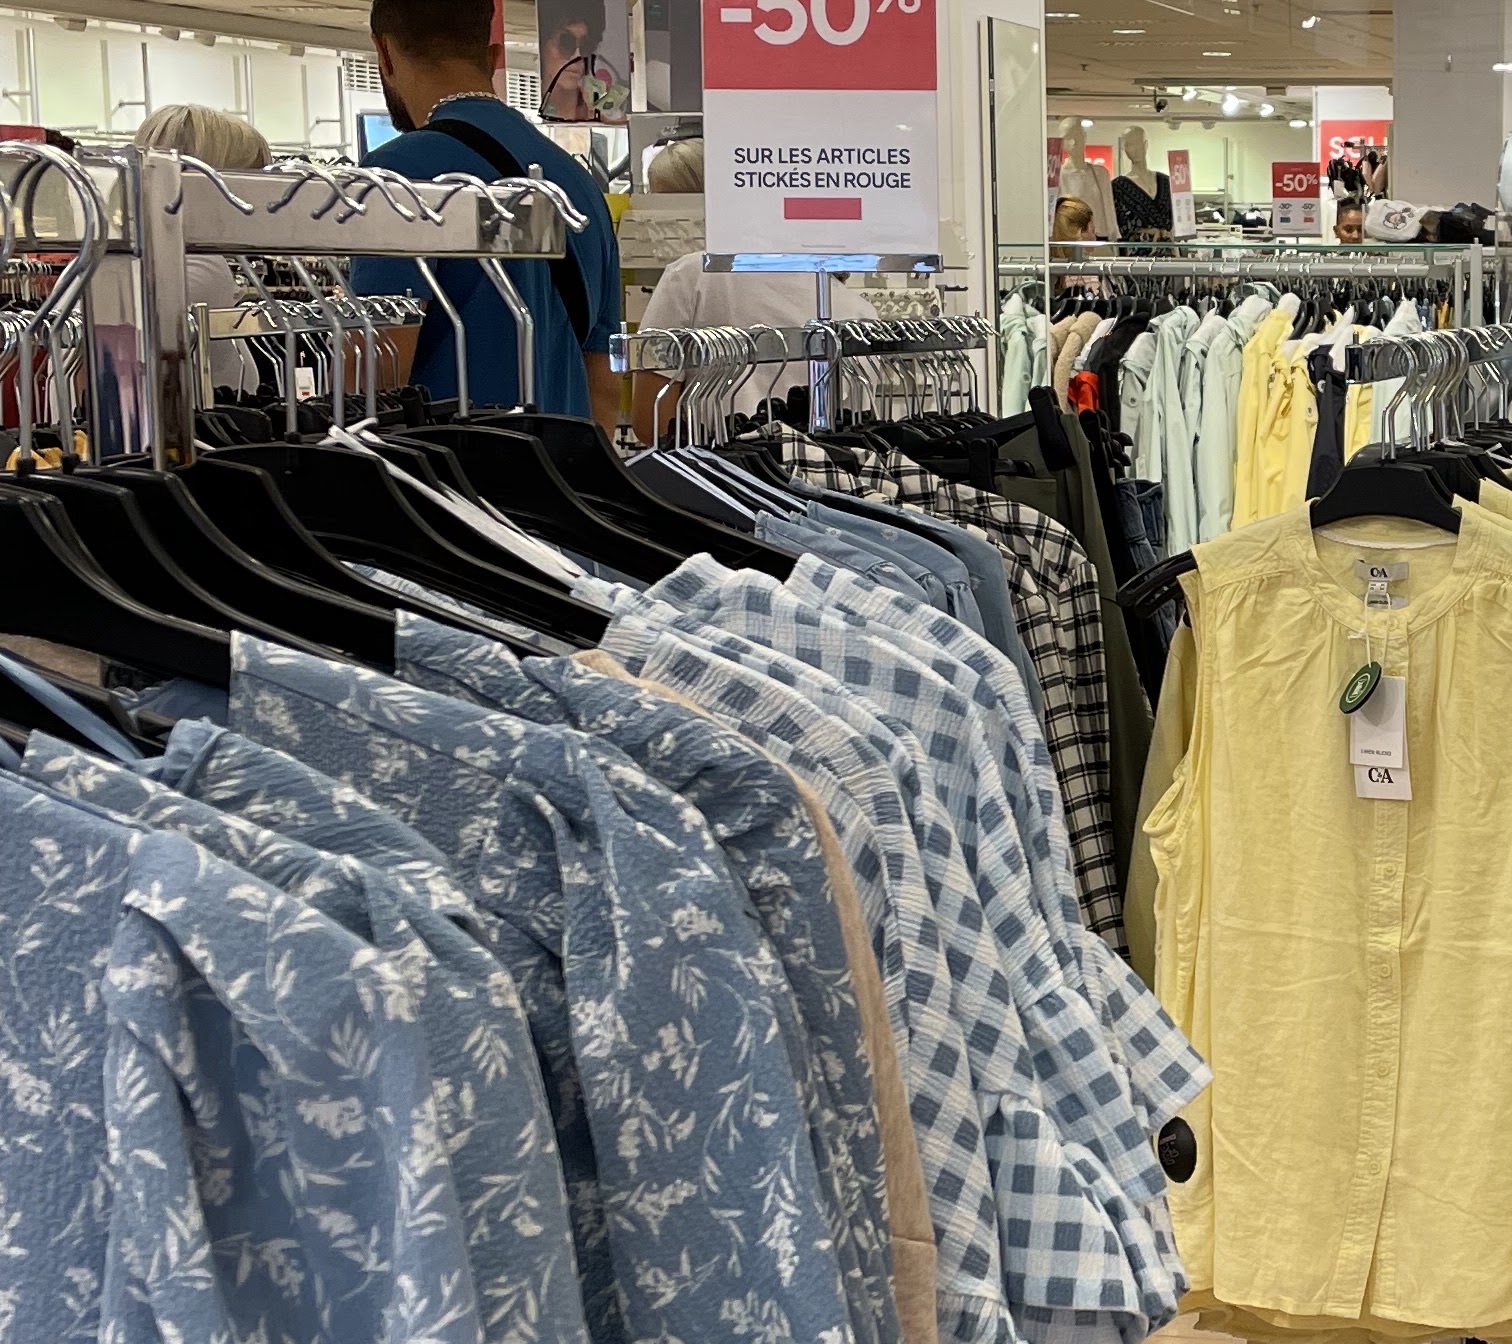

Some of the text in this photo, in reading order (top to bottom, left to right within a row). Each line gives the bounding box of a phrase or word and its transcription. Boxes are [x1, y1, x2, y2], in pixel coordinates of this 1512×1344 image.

[734, 147, 911, 165] SUR LES ARTICLES
[734, 166, 911, 189] STICKÉS EN ROUGE
[1275, 173, 1318, 192] -50%
[1367, 767, 1394, 784] C&A
